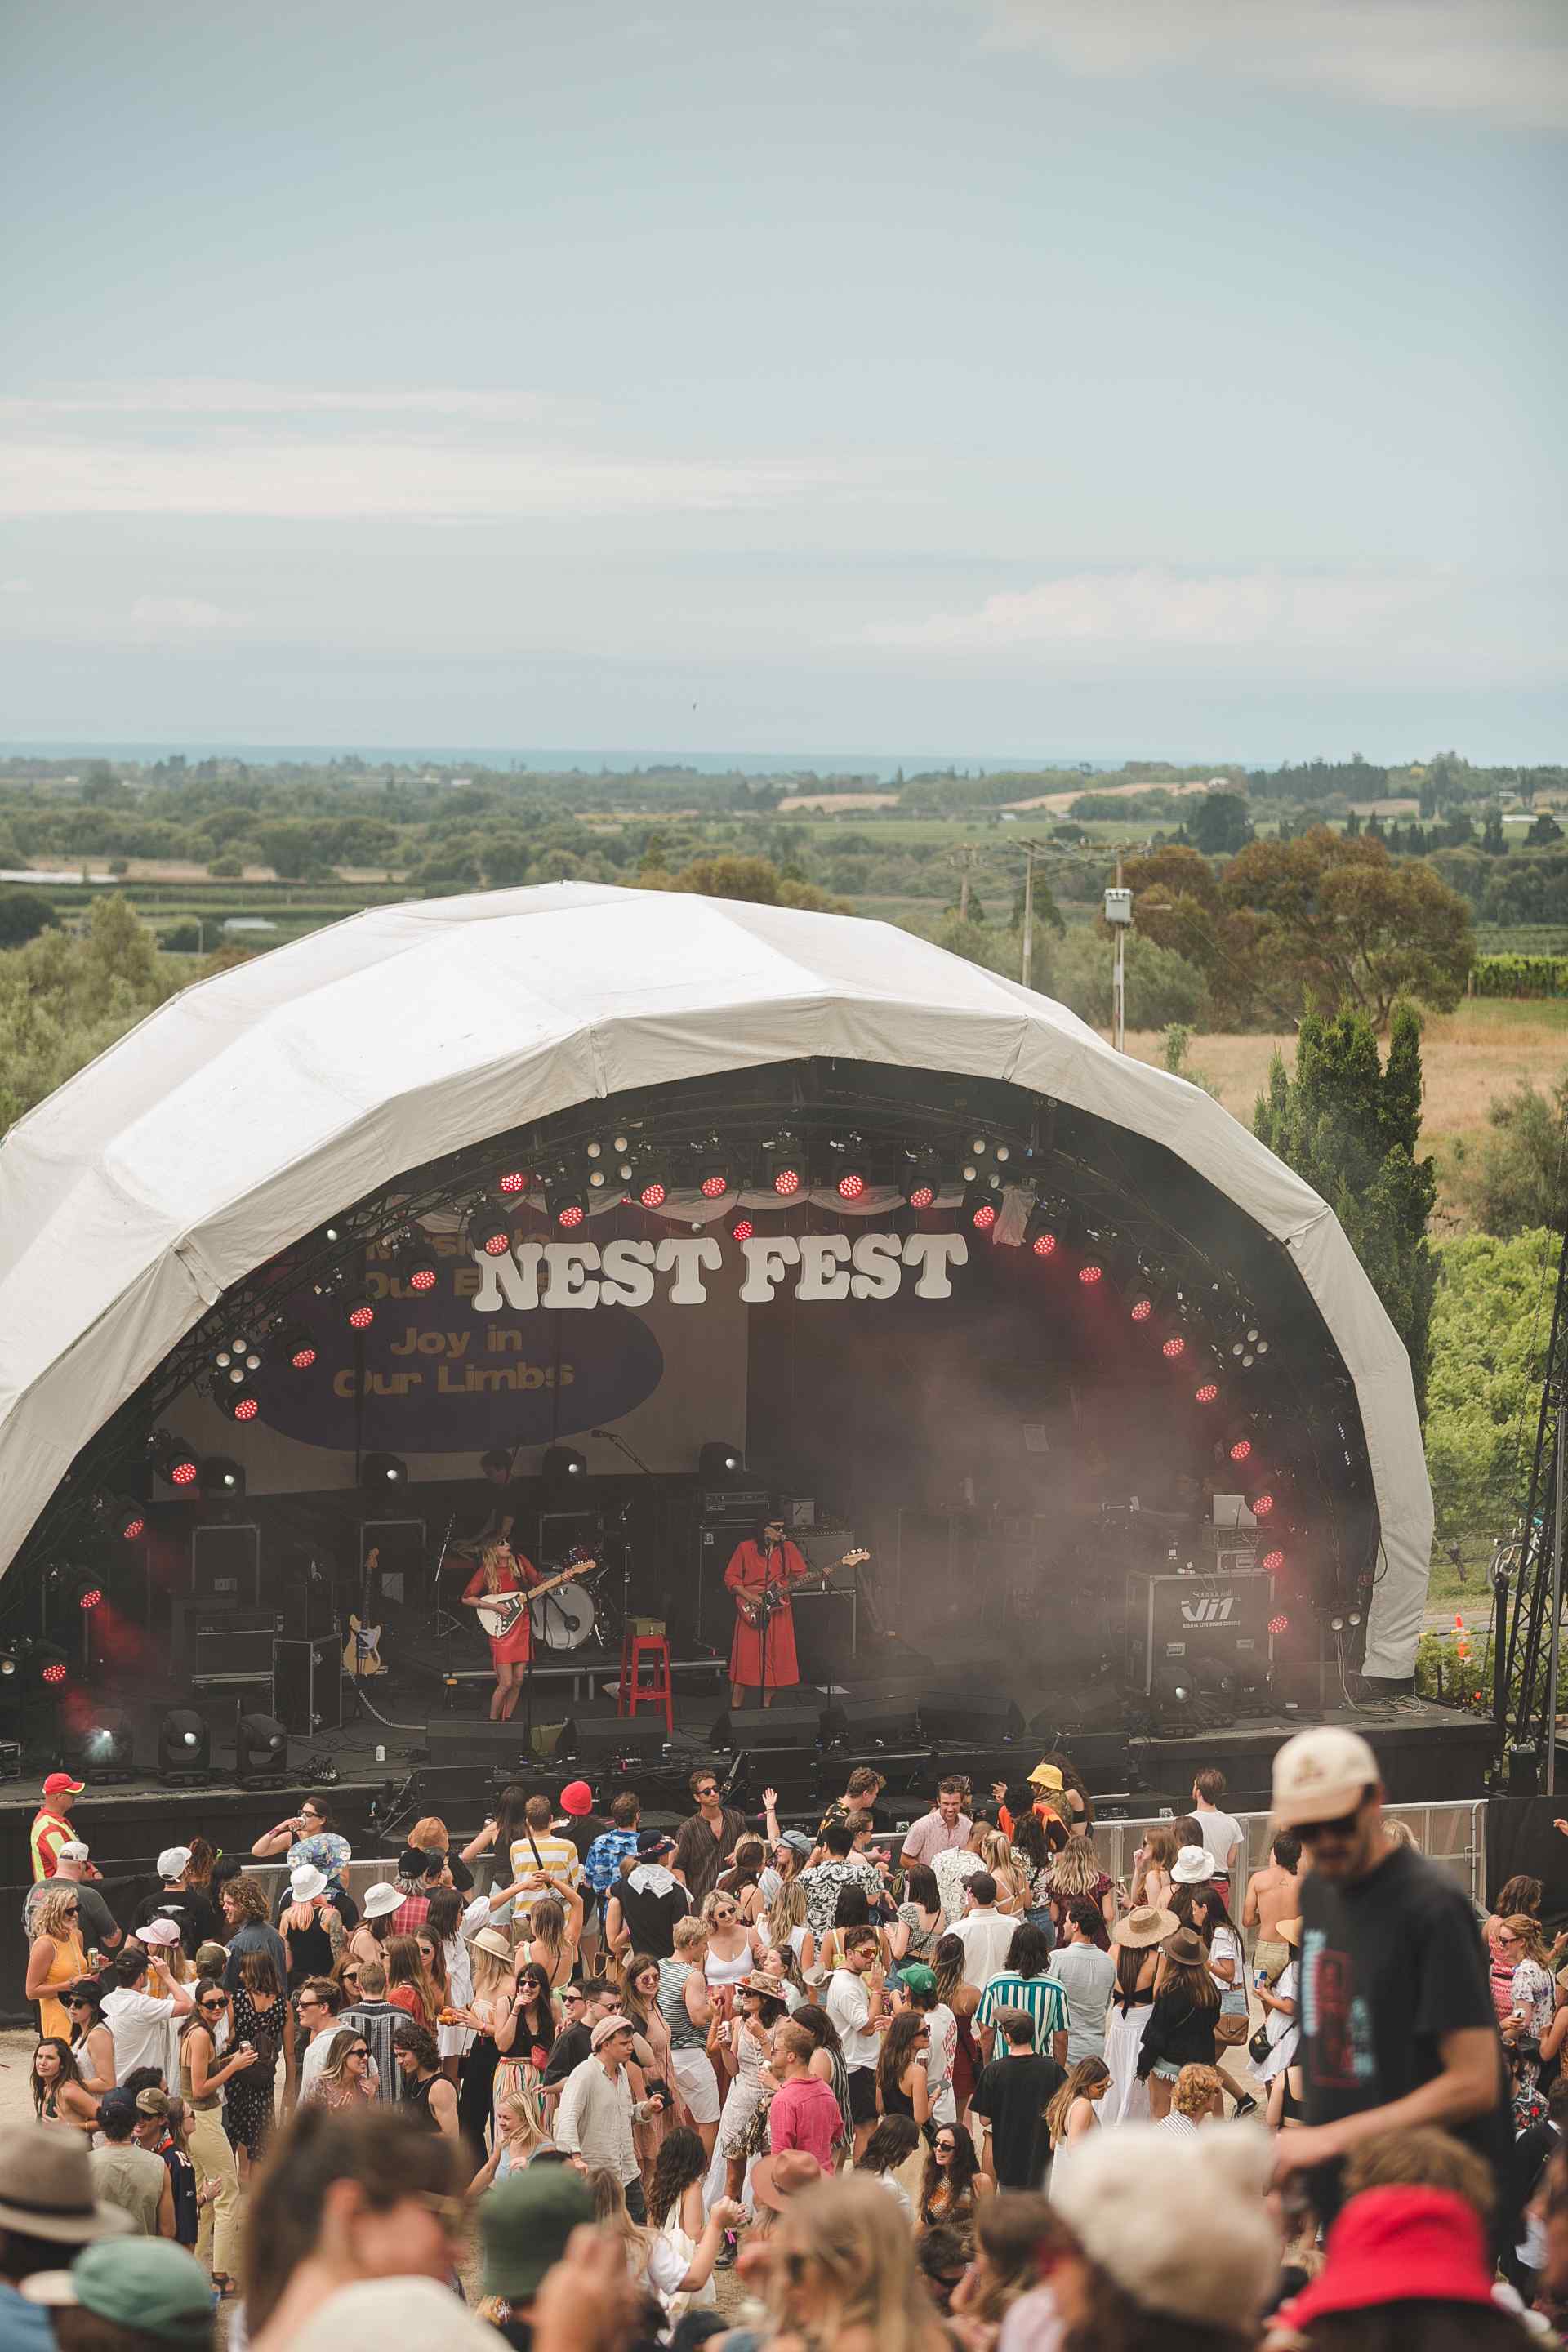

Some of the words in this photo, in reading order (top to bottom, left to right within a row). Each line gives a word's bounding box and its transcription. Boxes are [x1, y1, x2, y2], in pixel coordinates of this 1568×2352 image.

[472, 1237, 723, 1312] NEST
[739, 1233, 969, 1303] FEST
[390, 1327, 471, 1359] Joy
[488, 1324, 523, 1352] in
[332, 1369, 424, 1398] Our
[438, 1361, 574, 1393] Limbs
